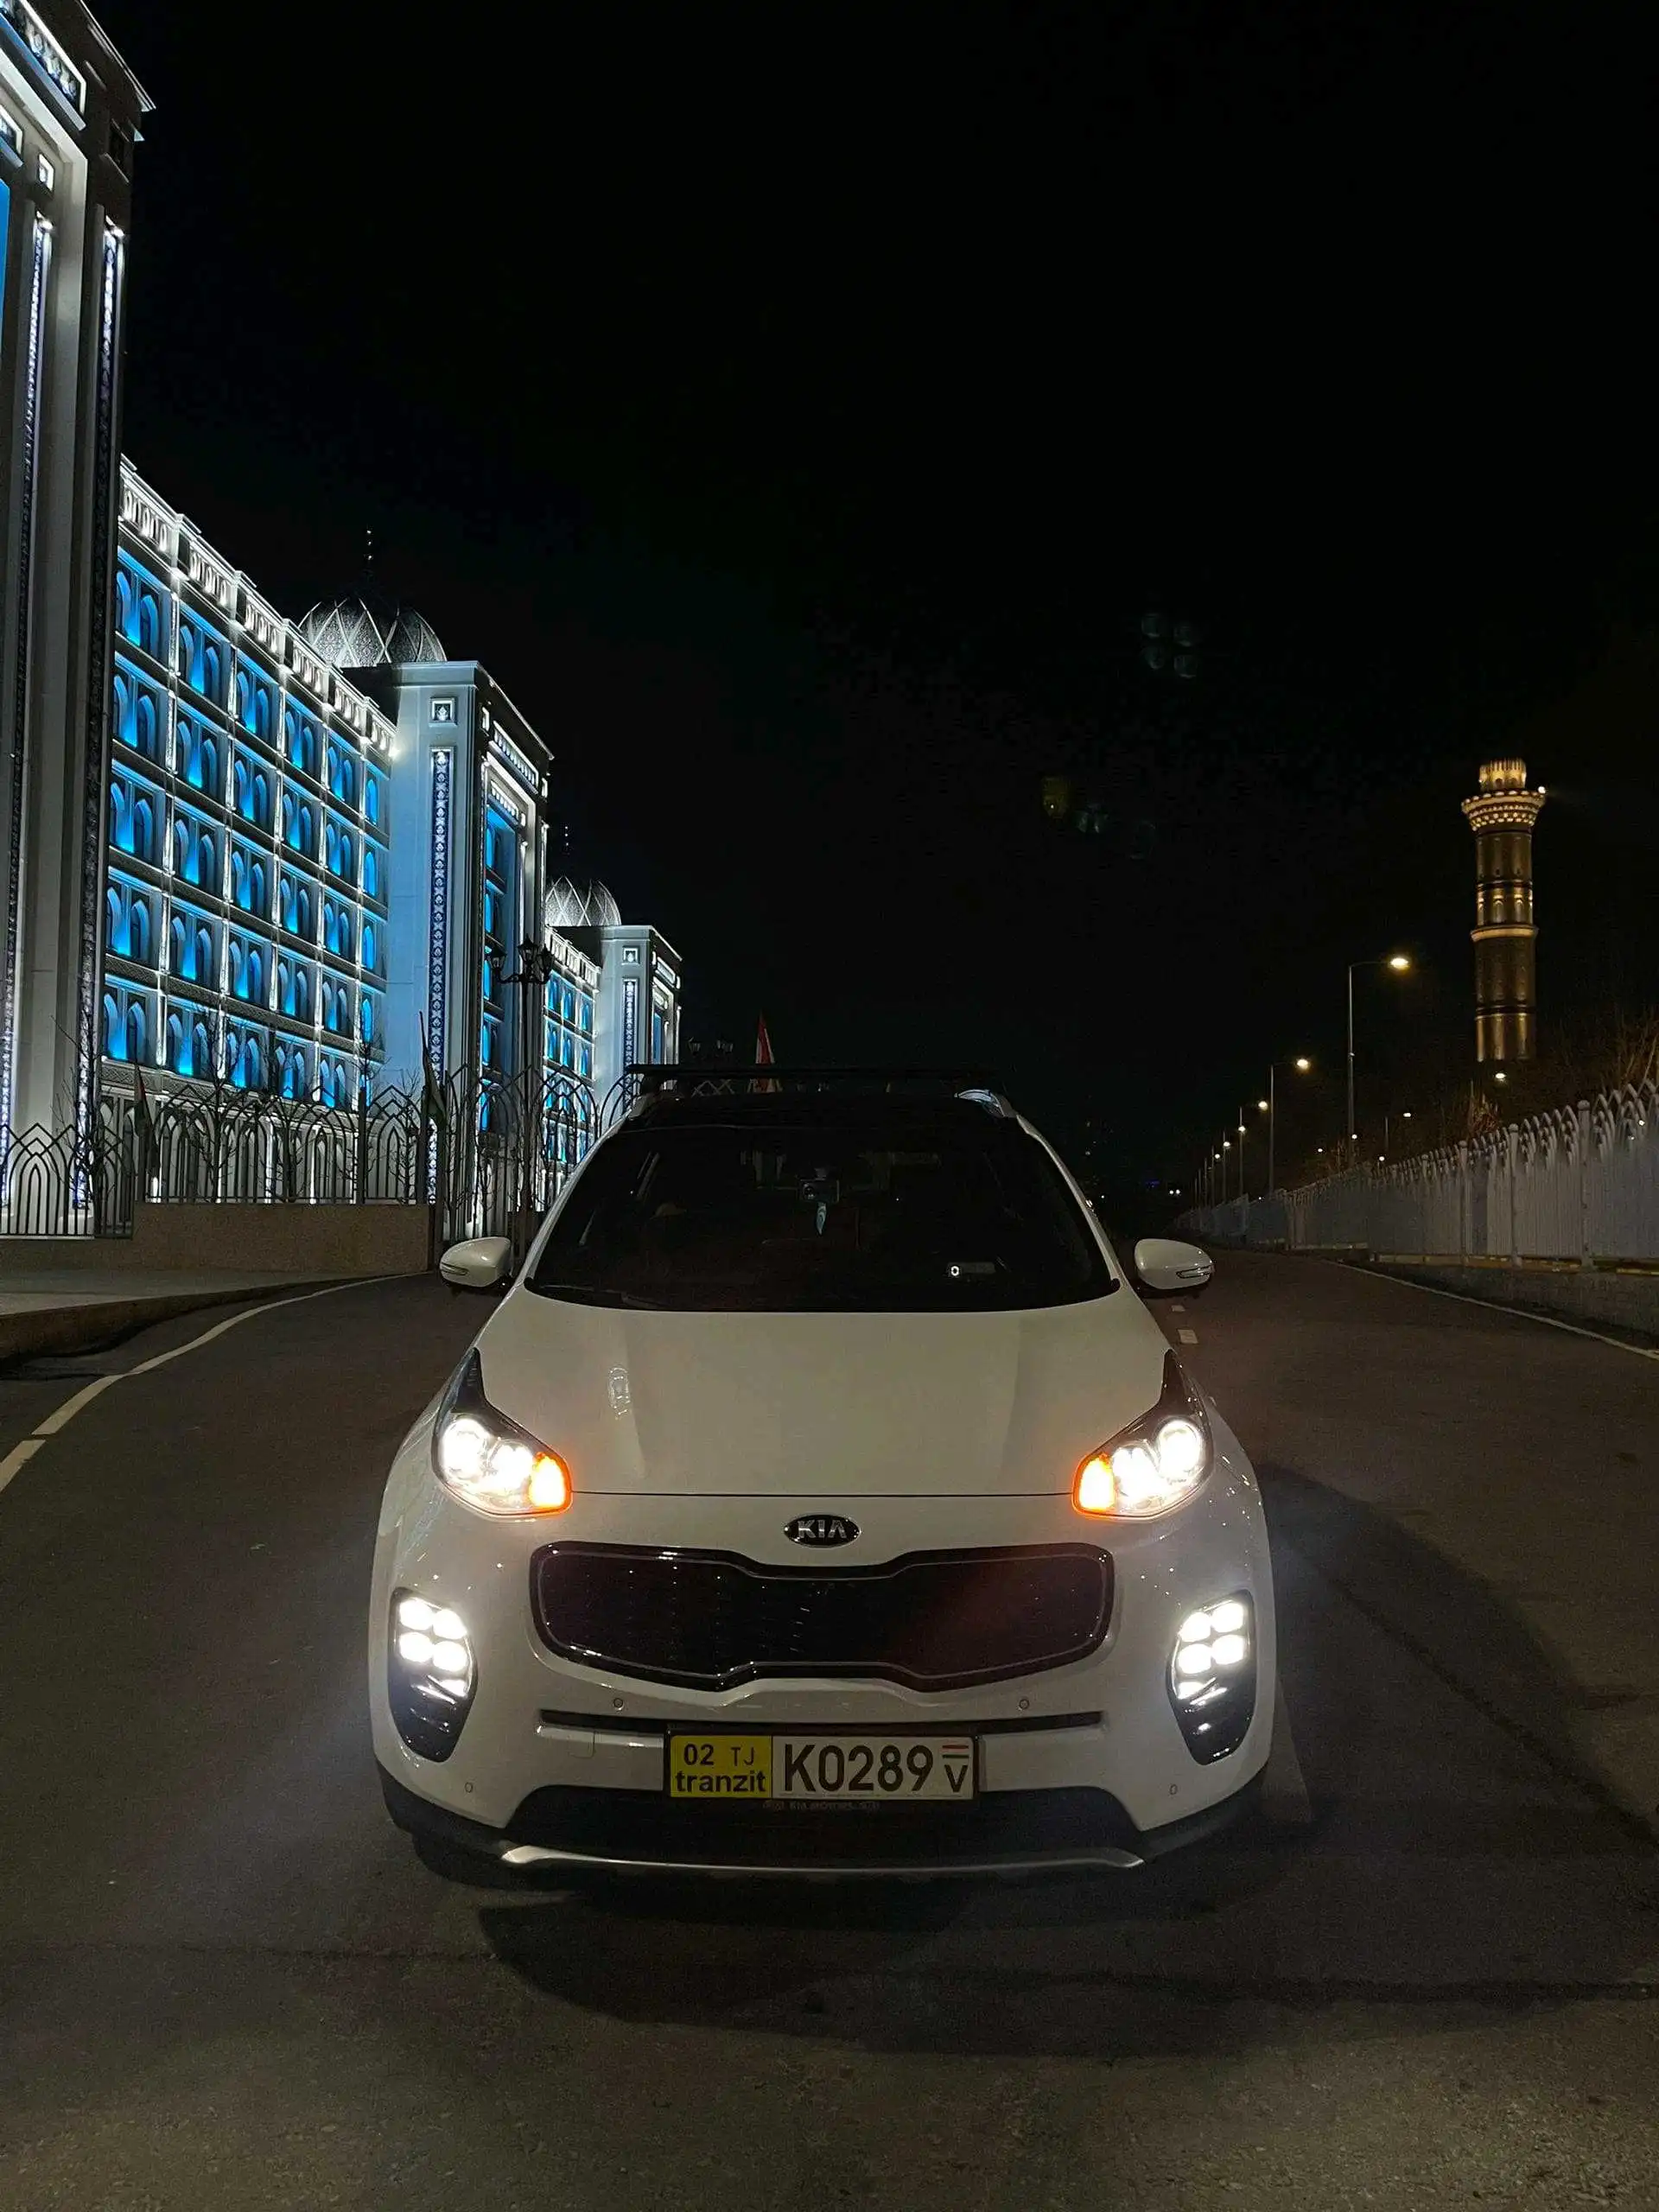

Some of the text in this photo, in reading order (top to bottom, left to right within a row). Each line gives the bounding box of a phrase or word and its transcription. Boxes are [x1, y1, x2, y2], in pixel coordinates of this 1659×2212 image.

[798, 1519, 848, 1538] KIA
[683, 1744, 754, 1766] 02 TJ
[785, 1744, 934, 1792] K0289
[675, 1770, 766, 1793] tranzit
